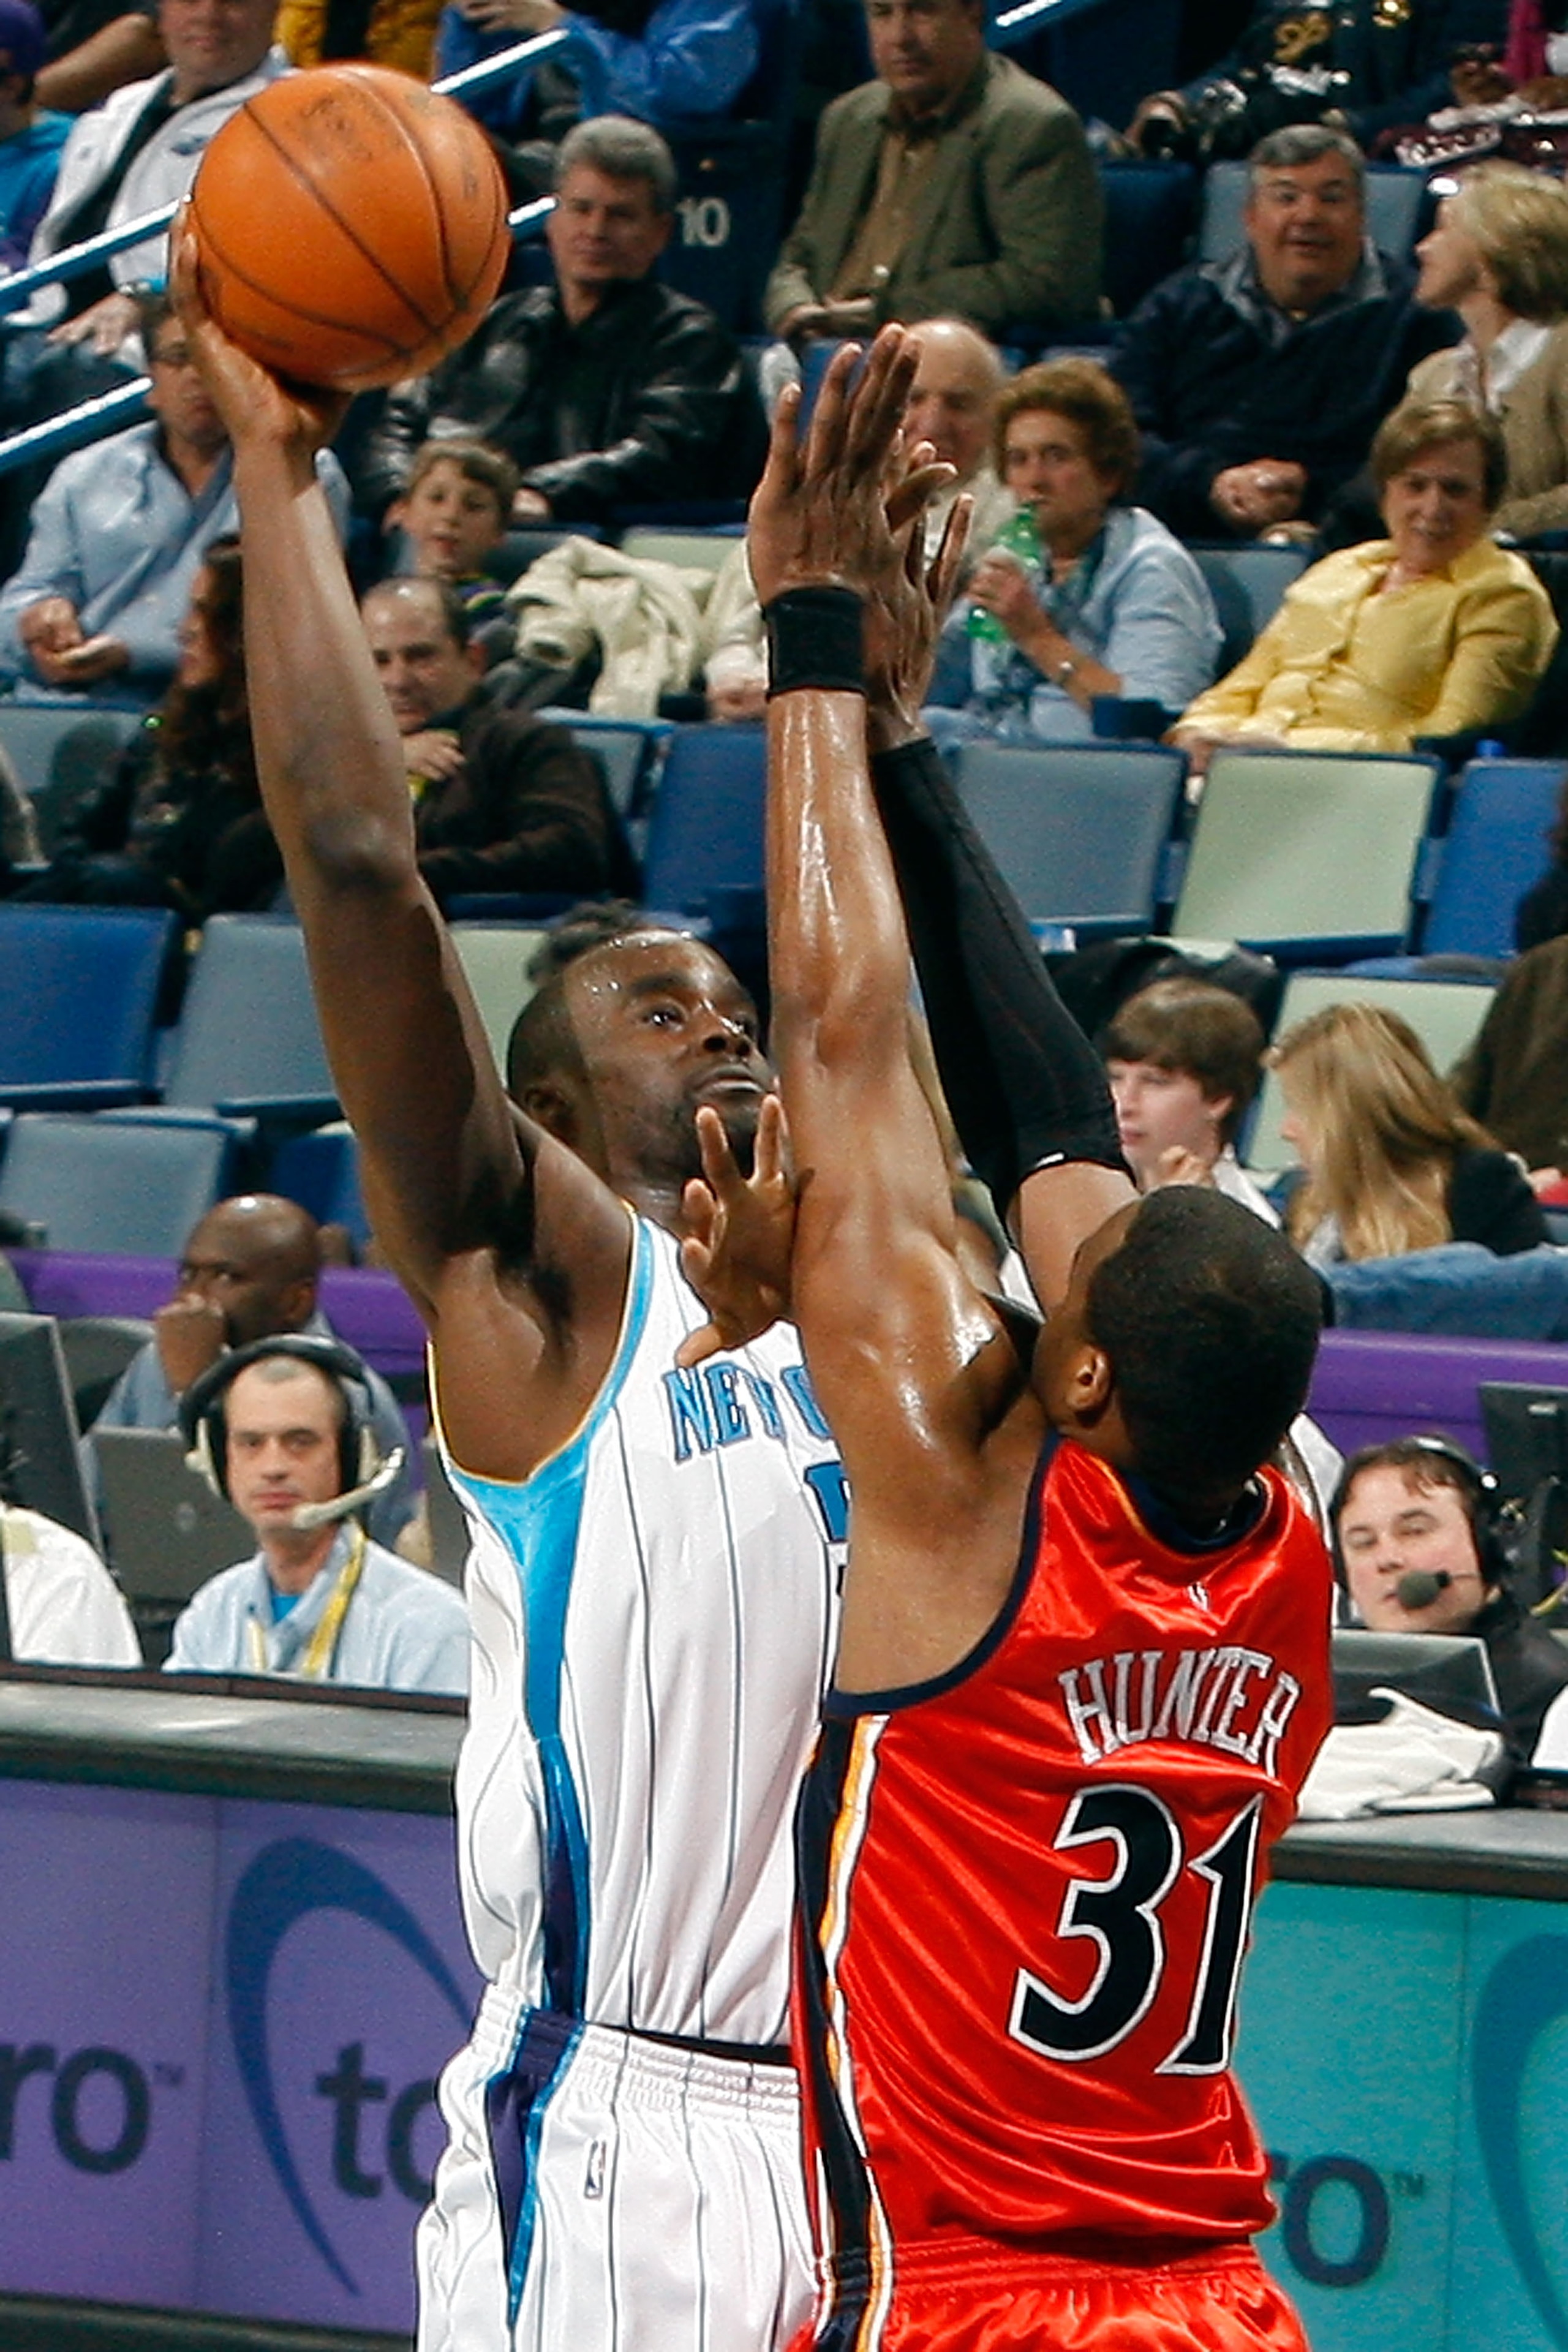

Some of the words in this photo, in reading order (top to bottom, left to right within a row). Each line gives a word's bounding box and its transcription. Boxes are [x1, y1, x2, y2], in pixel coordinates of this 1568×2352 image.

[676, 197, 729, 246] 10
[1058, 1645, 1301, 1779] HUNTER
[1008, 1782, 1264, 2075] 31
